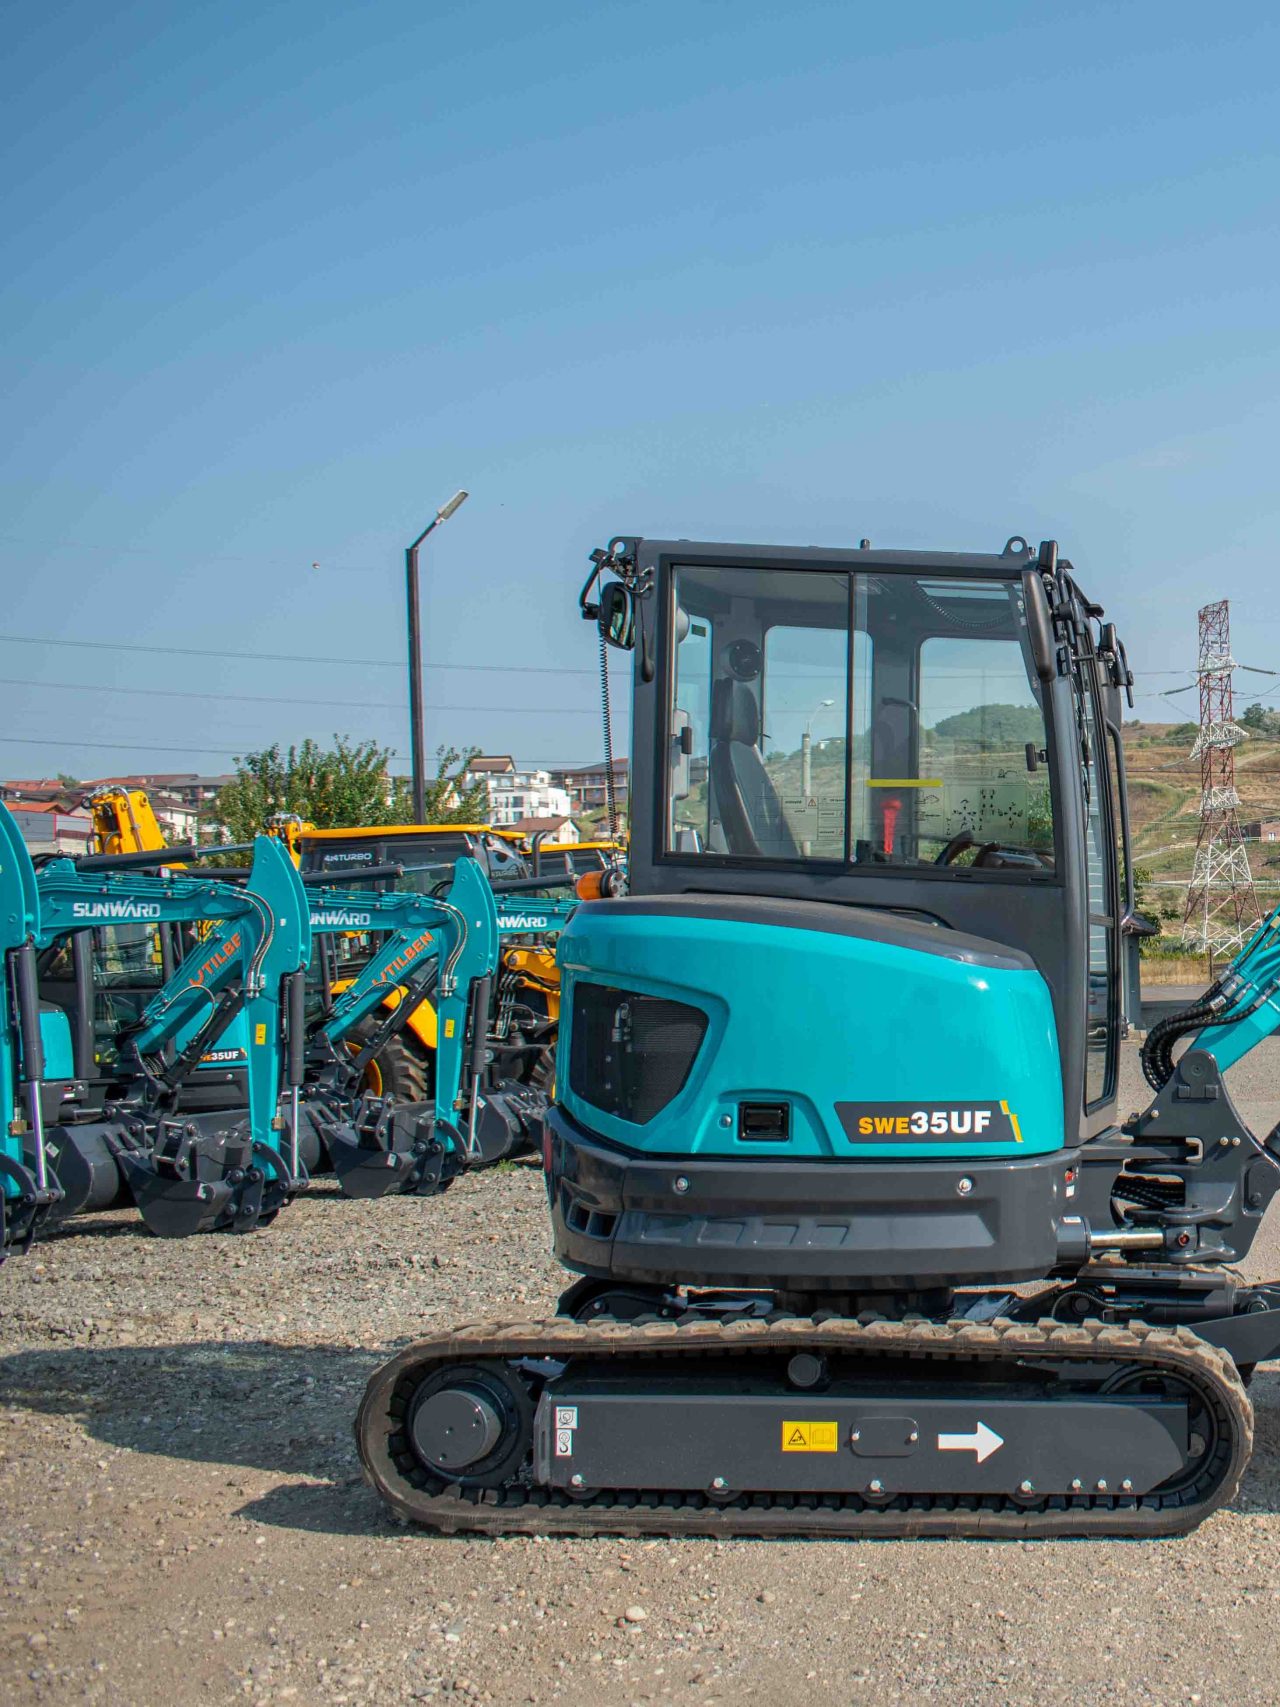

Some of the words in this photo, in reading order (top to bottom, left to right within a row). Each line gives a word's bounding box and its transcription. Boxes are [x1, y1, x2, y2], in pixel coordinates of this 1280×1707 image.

[73, 896, 160, 917] SUNWARD
[309, 907, 371, 926] NWARD
[496, 912, 548, 928] NWARD
